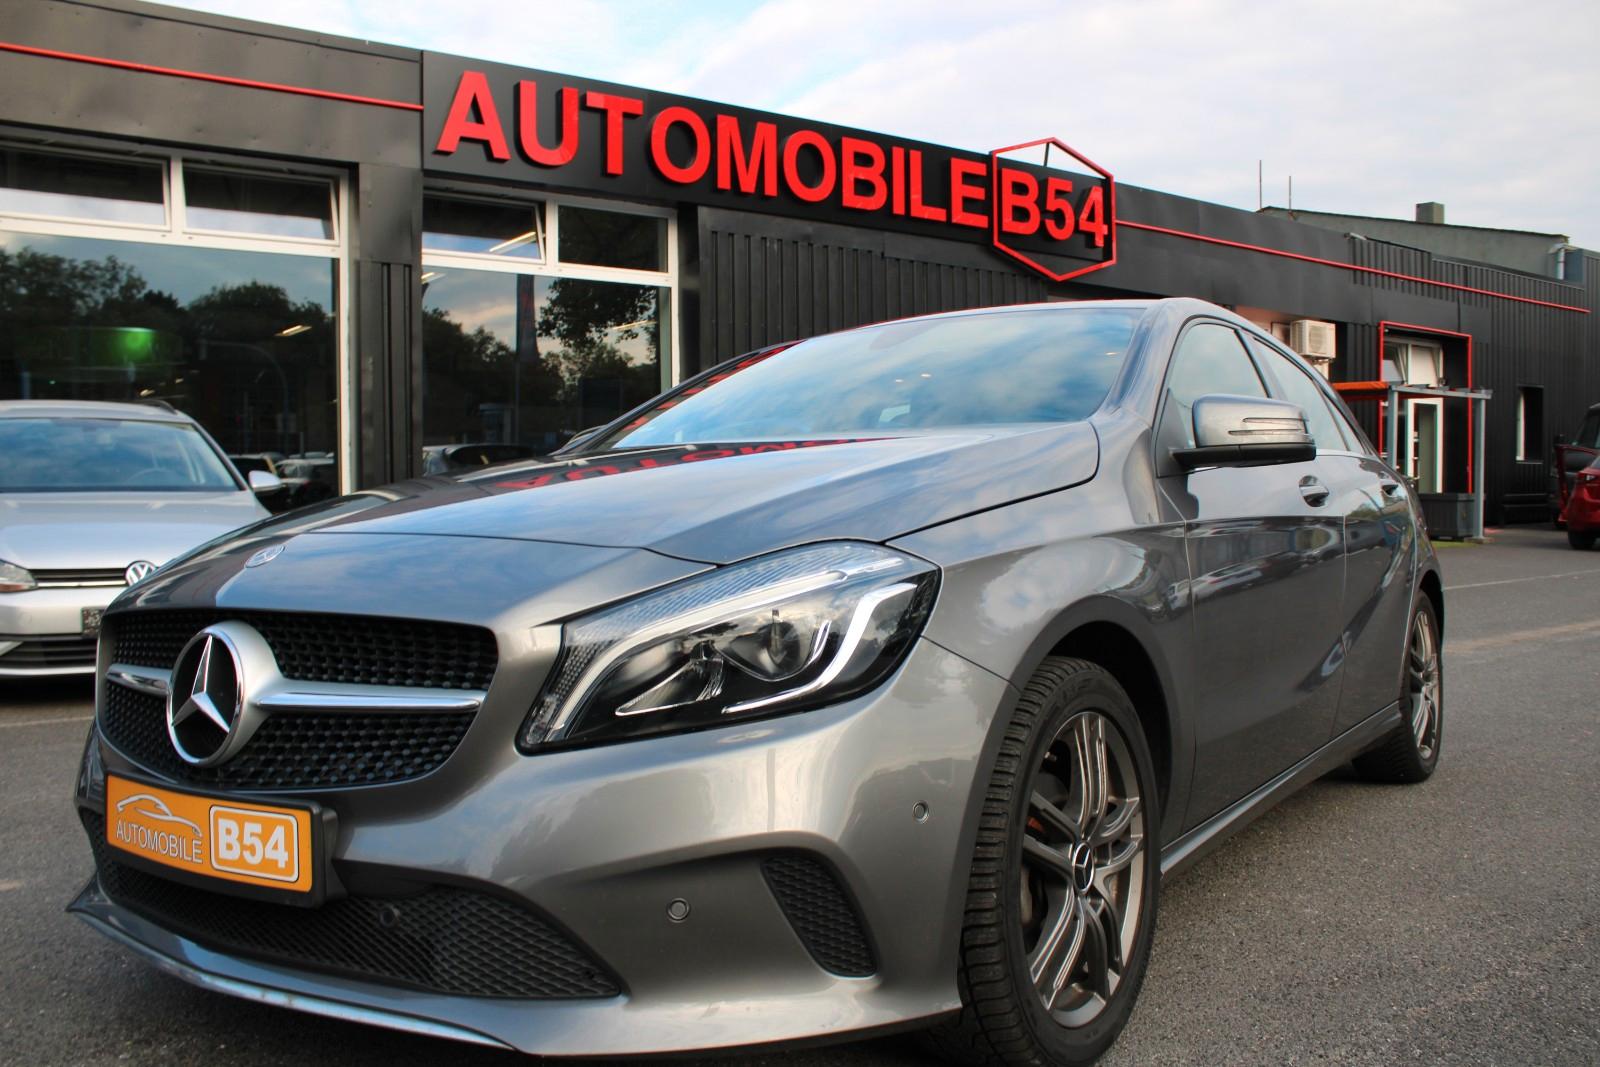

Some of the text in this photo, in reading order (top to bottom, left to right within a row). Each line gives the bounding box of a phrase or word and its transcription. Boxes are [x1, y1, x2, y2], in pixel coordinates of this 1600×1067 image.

[436, 70, 1109, 248] AUTOMOBILE B54
[115, 818, 289, 869] AUTOMOBILE B54
